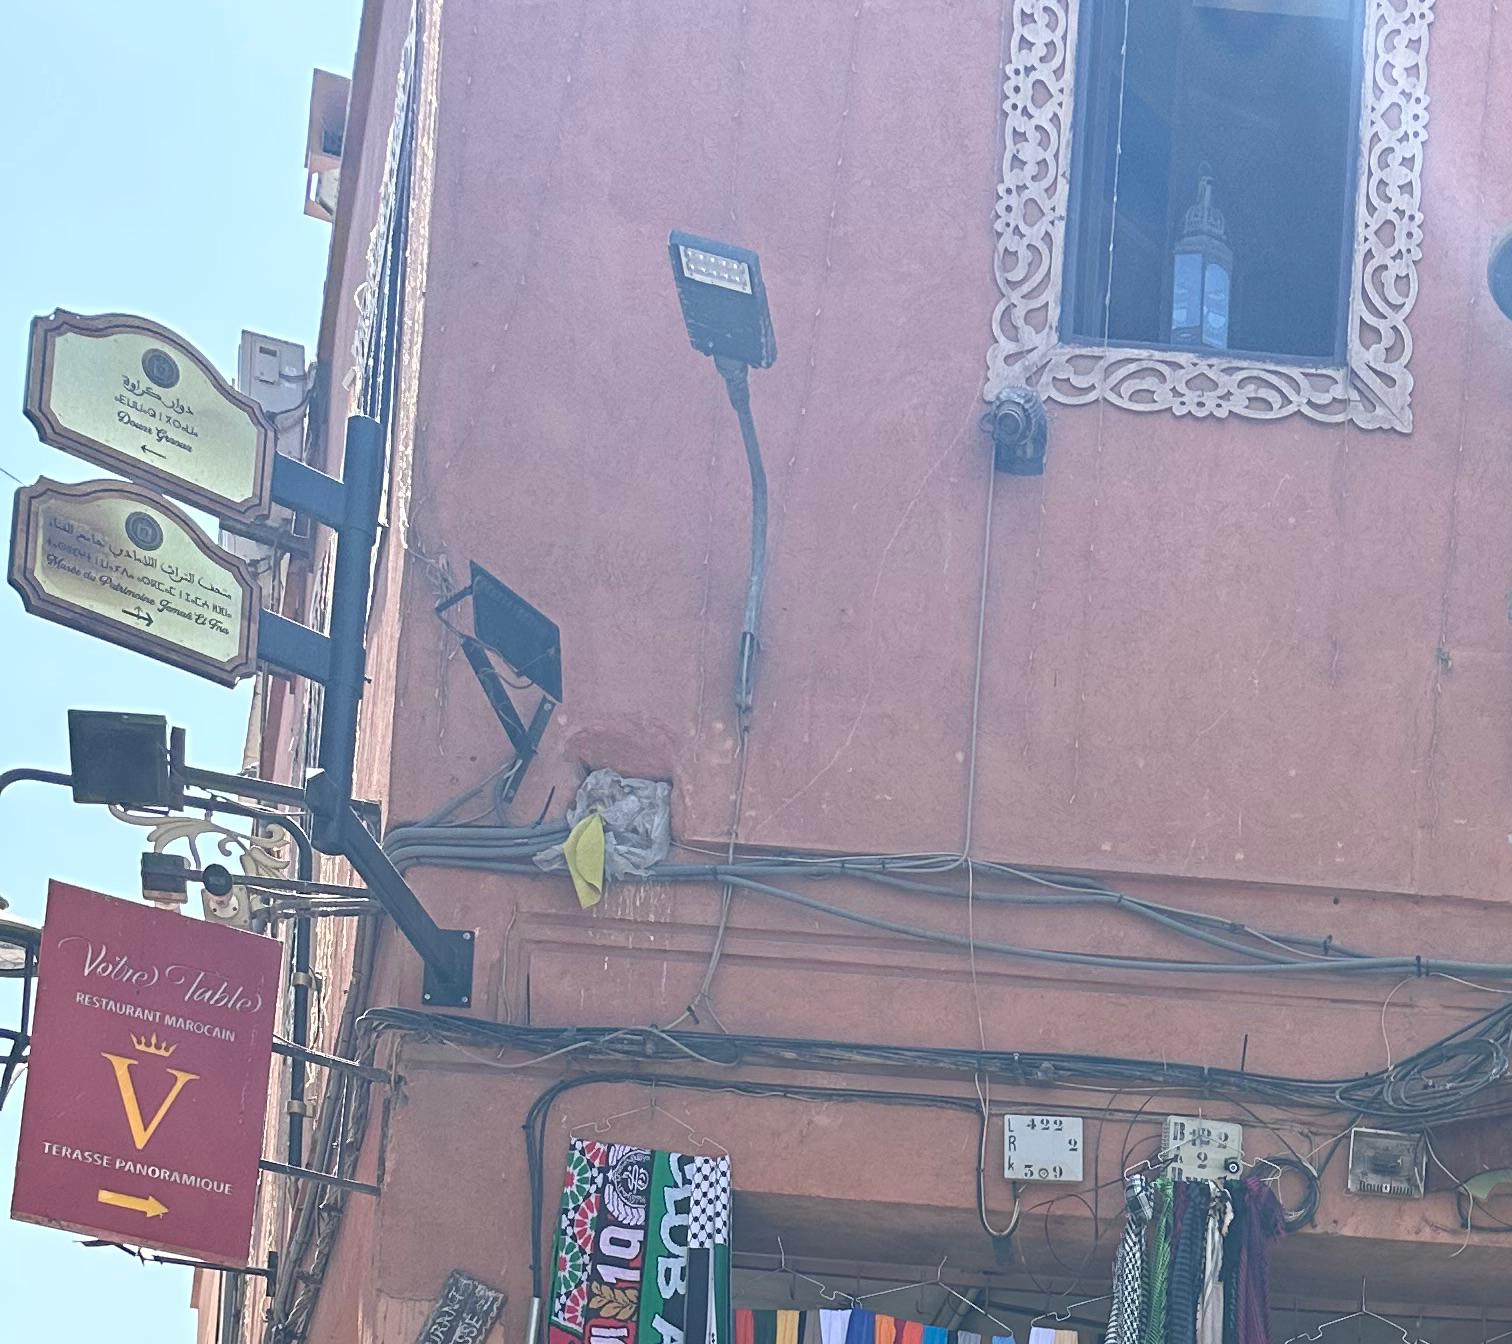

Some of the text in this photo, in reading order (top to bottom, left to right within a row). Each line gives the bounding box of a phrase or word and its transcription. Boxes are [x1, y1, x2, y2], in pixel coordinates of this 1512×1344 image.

[76, 991, 236, 1043] RESTAURANT MAROCAIN
[101, 1051, 200, 1150] V
[42, 1140, 234, 1196] TERASSE PANORAMIQUE
